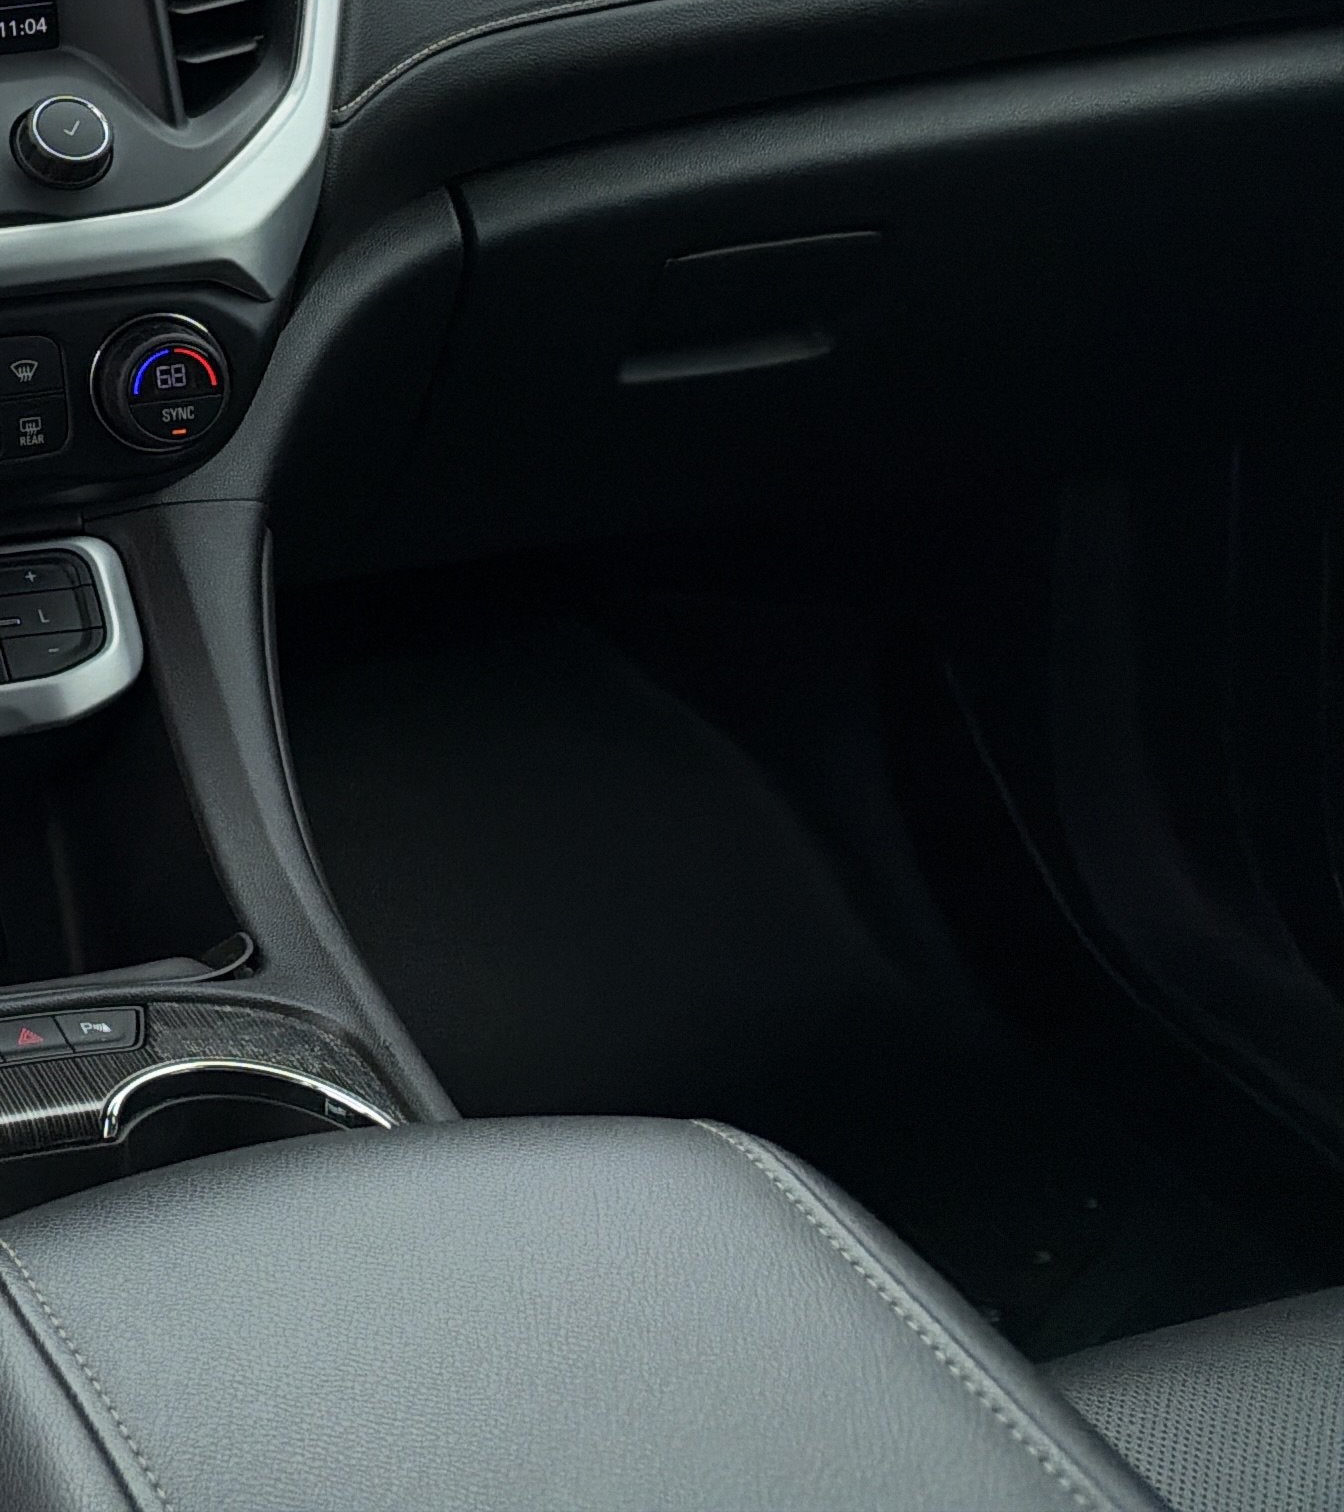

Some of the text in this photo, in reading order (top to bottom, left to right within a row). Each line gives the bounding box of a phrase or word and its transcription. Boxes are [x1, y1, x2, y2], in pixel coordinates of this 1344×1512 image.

[156, 363, 187, 389] 68
[162, 405, 195, 423] SYNC
[19, 433, 44, 447] REAR
[37, 609, 50, 624] L
